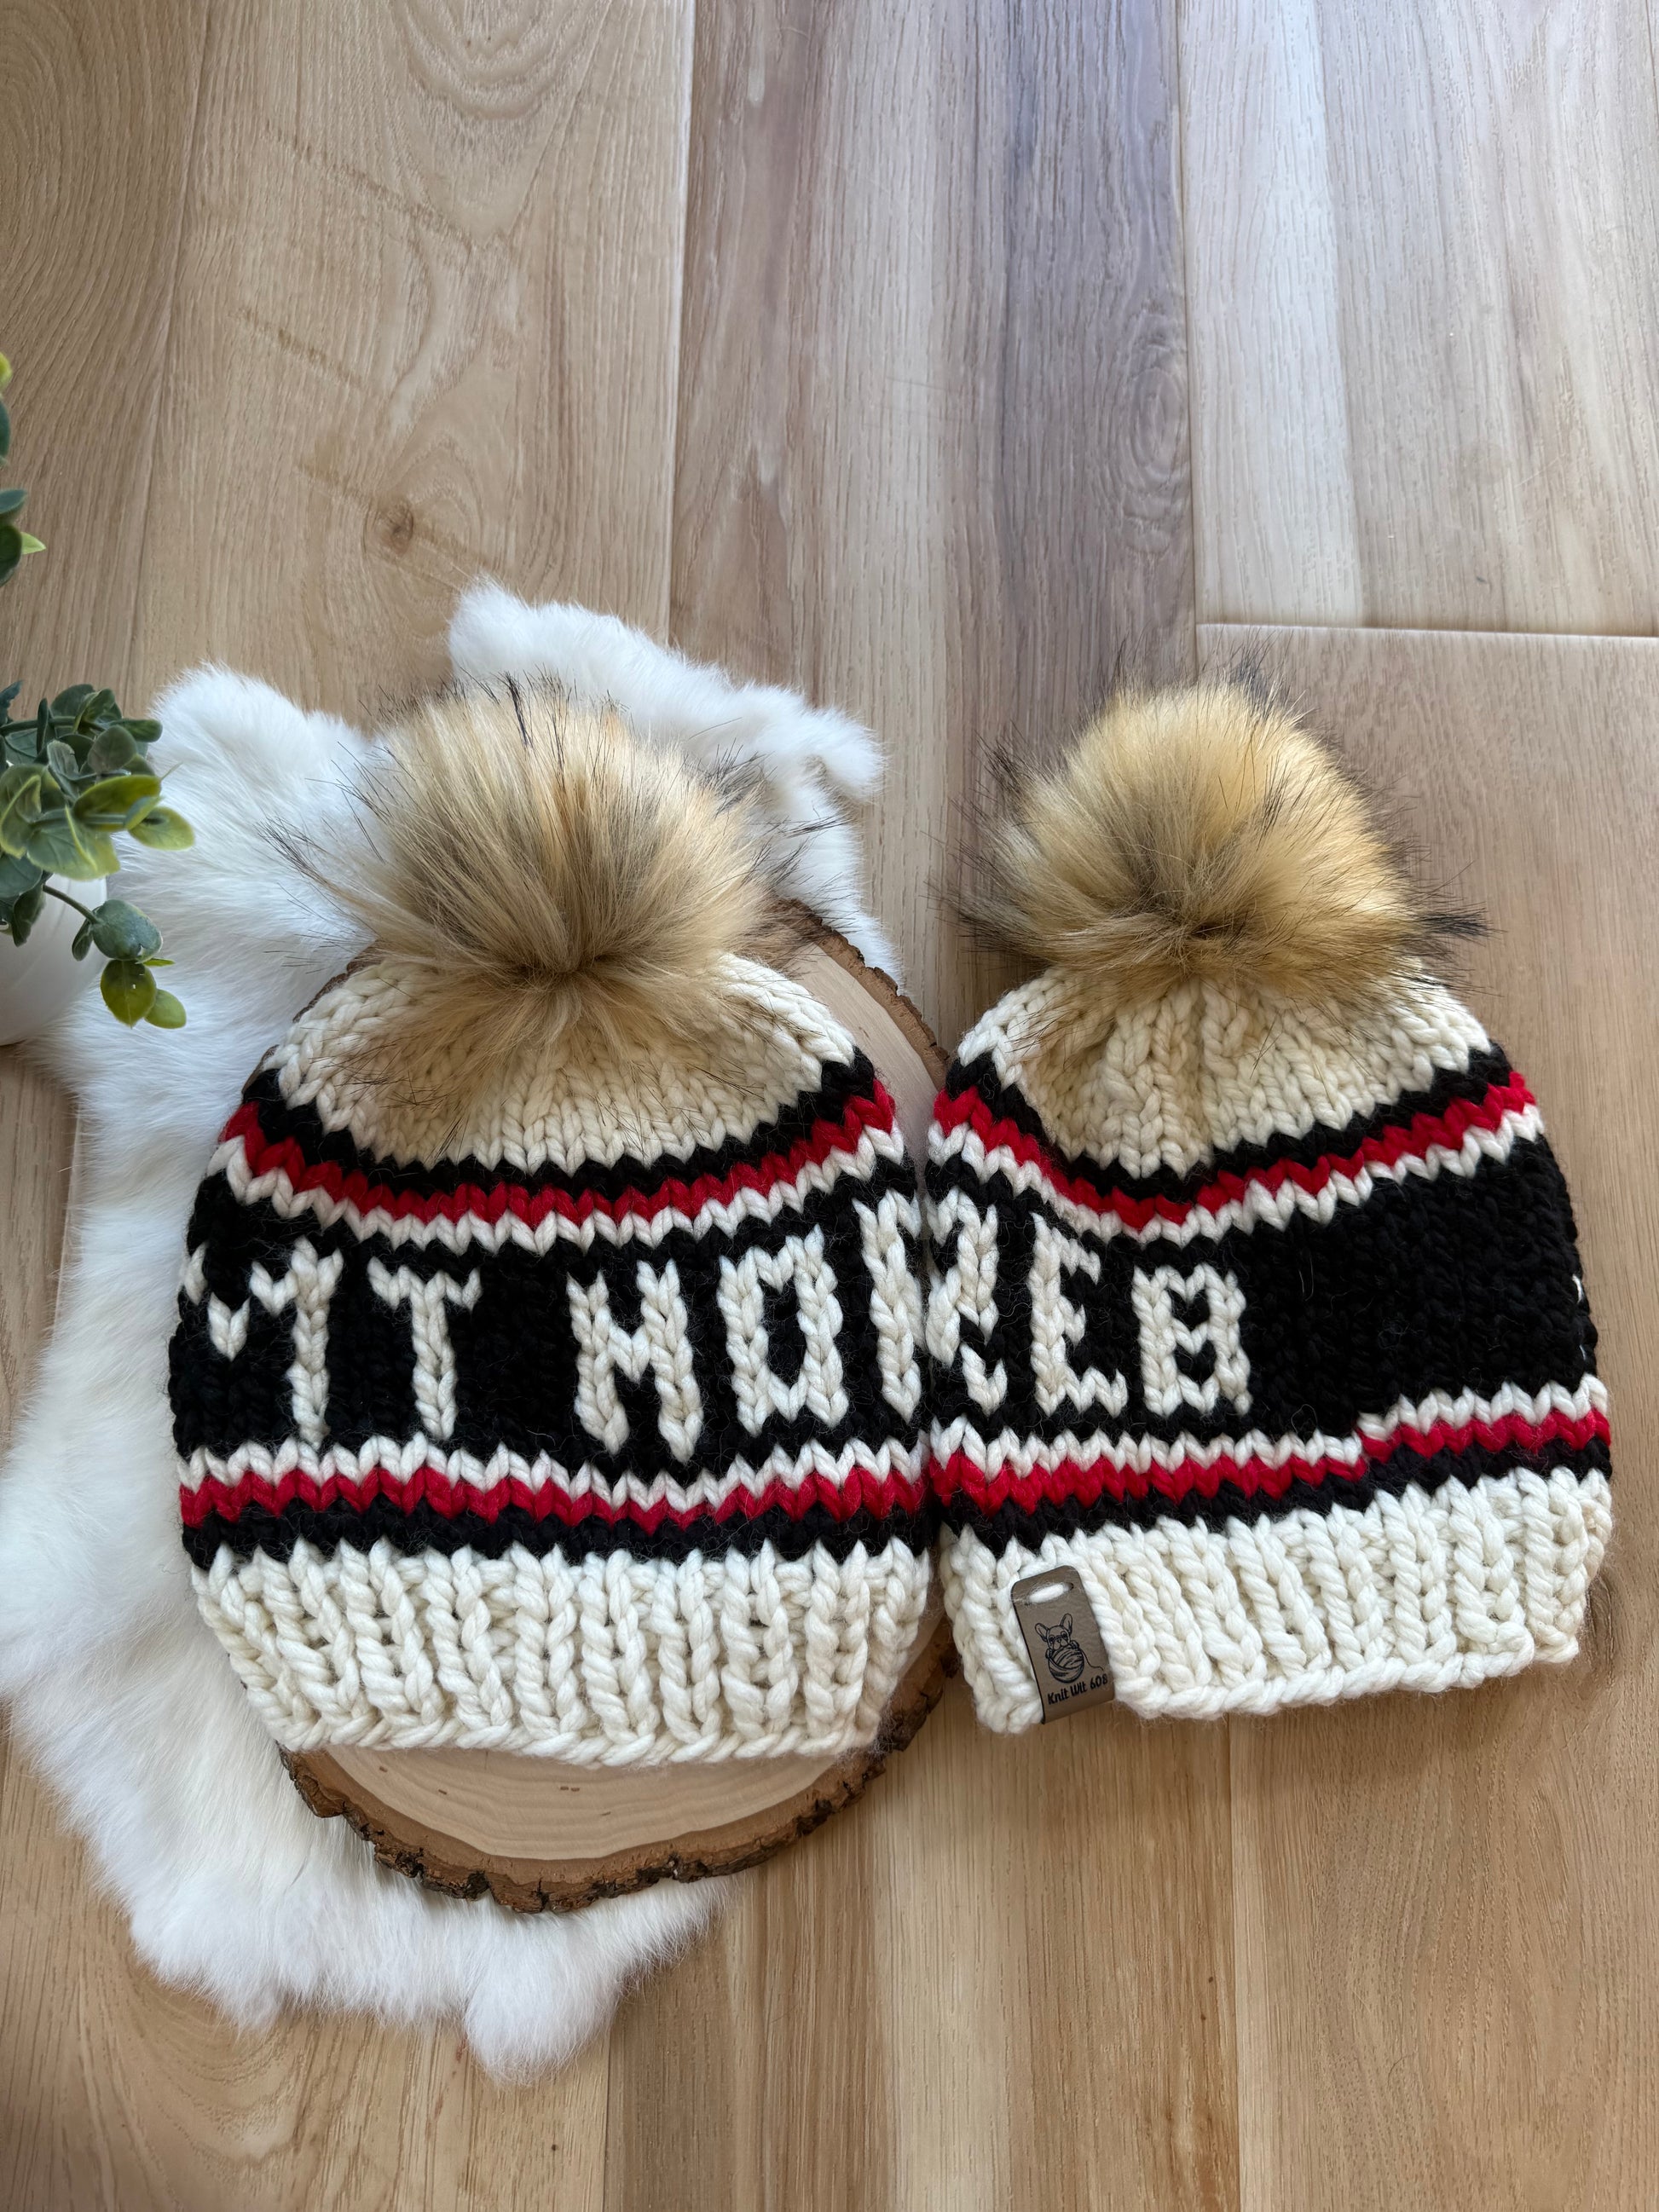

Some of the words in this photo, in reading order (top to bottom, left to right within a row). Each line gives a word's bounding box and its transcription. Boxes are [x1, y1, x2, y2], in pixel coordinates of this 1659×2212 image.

[1048, 1688, 1070, 1705] Knit
[1070, 1681, 1088, 1696] Wit
[1090, 1673, 1108, 1689] 608
